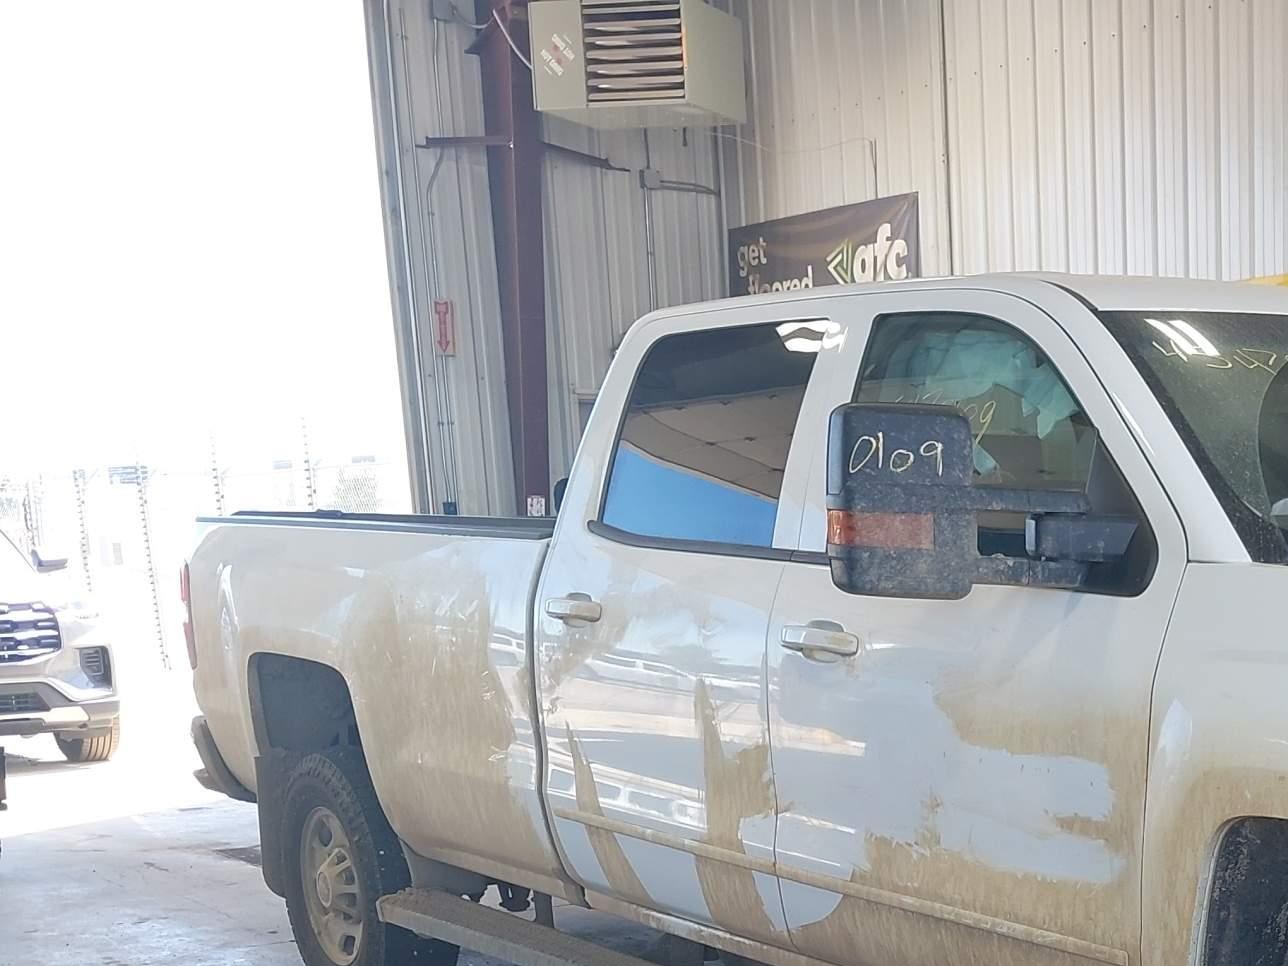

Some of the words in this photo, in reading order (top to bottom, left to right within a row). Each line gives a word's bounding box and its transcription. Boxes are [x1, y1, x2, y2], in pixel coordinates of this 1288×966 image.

[737, 237, 767, 277] get
[853, 223, 908, 282] afc
[848, 431, 944, 477] 0109
